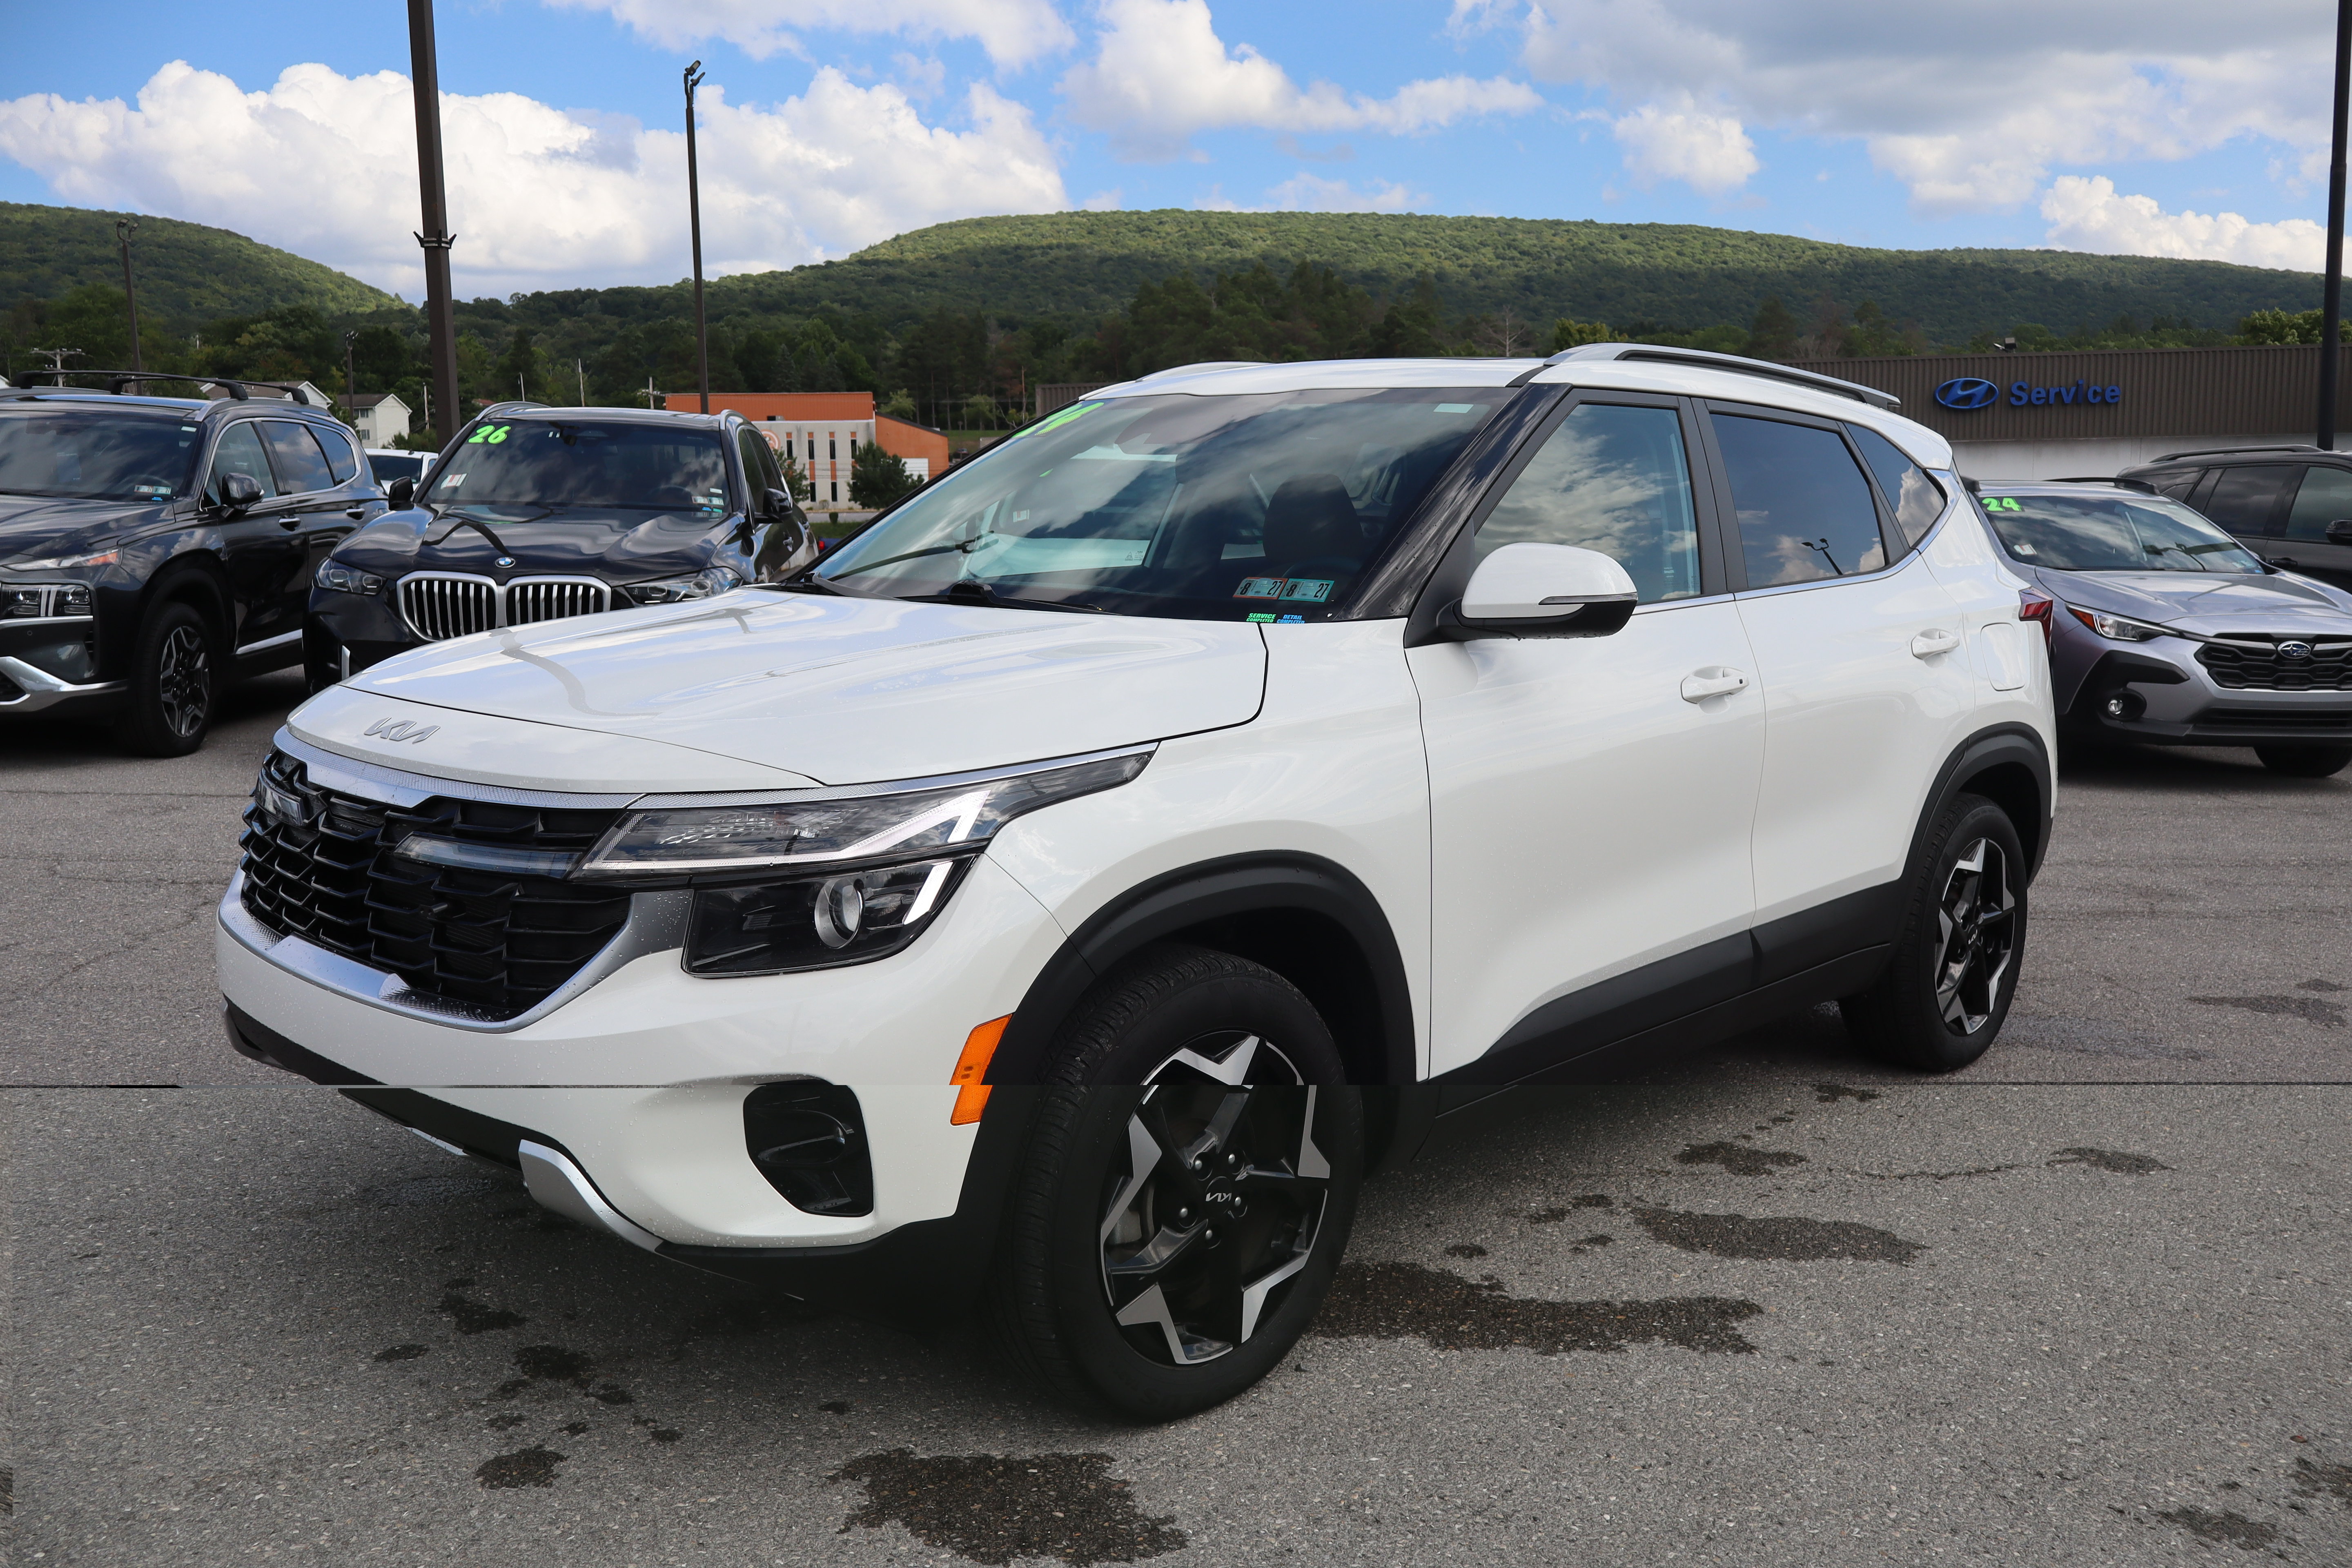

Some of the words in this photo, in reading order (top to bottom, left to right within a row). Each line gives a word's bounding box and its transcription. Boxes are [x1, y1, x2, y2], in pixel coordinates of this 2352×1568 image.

[2009, 379, 2121, 406] Service
[468, 425, 512, 444] 26
[1982, 497, 2022, 512] 24
[1240, 582, 1252, 595] 8
[1267, 581, 1283, 596] 27
[1286, 584, 1298, 597] 8
[1313, 583, 1330, 598] 27
[363, 717, 441, 745] KIA
